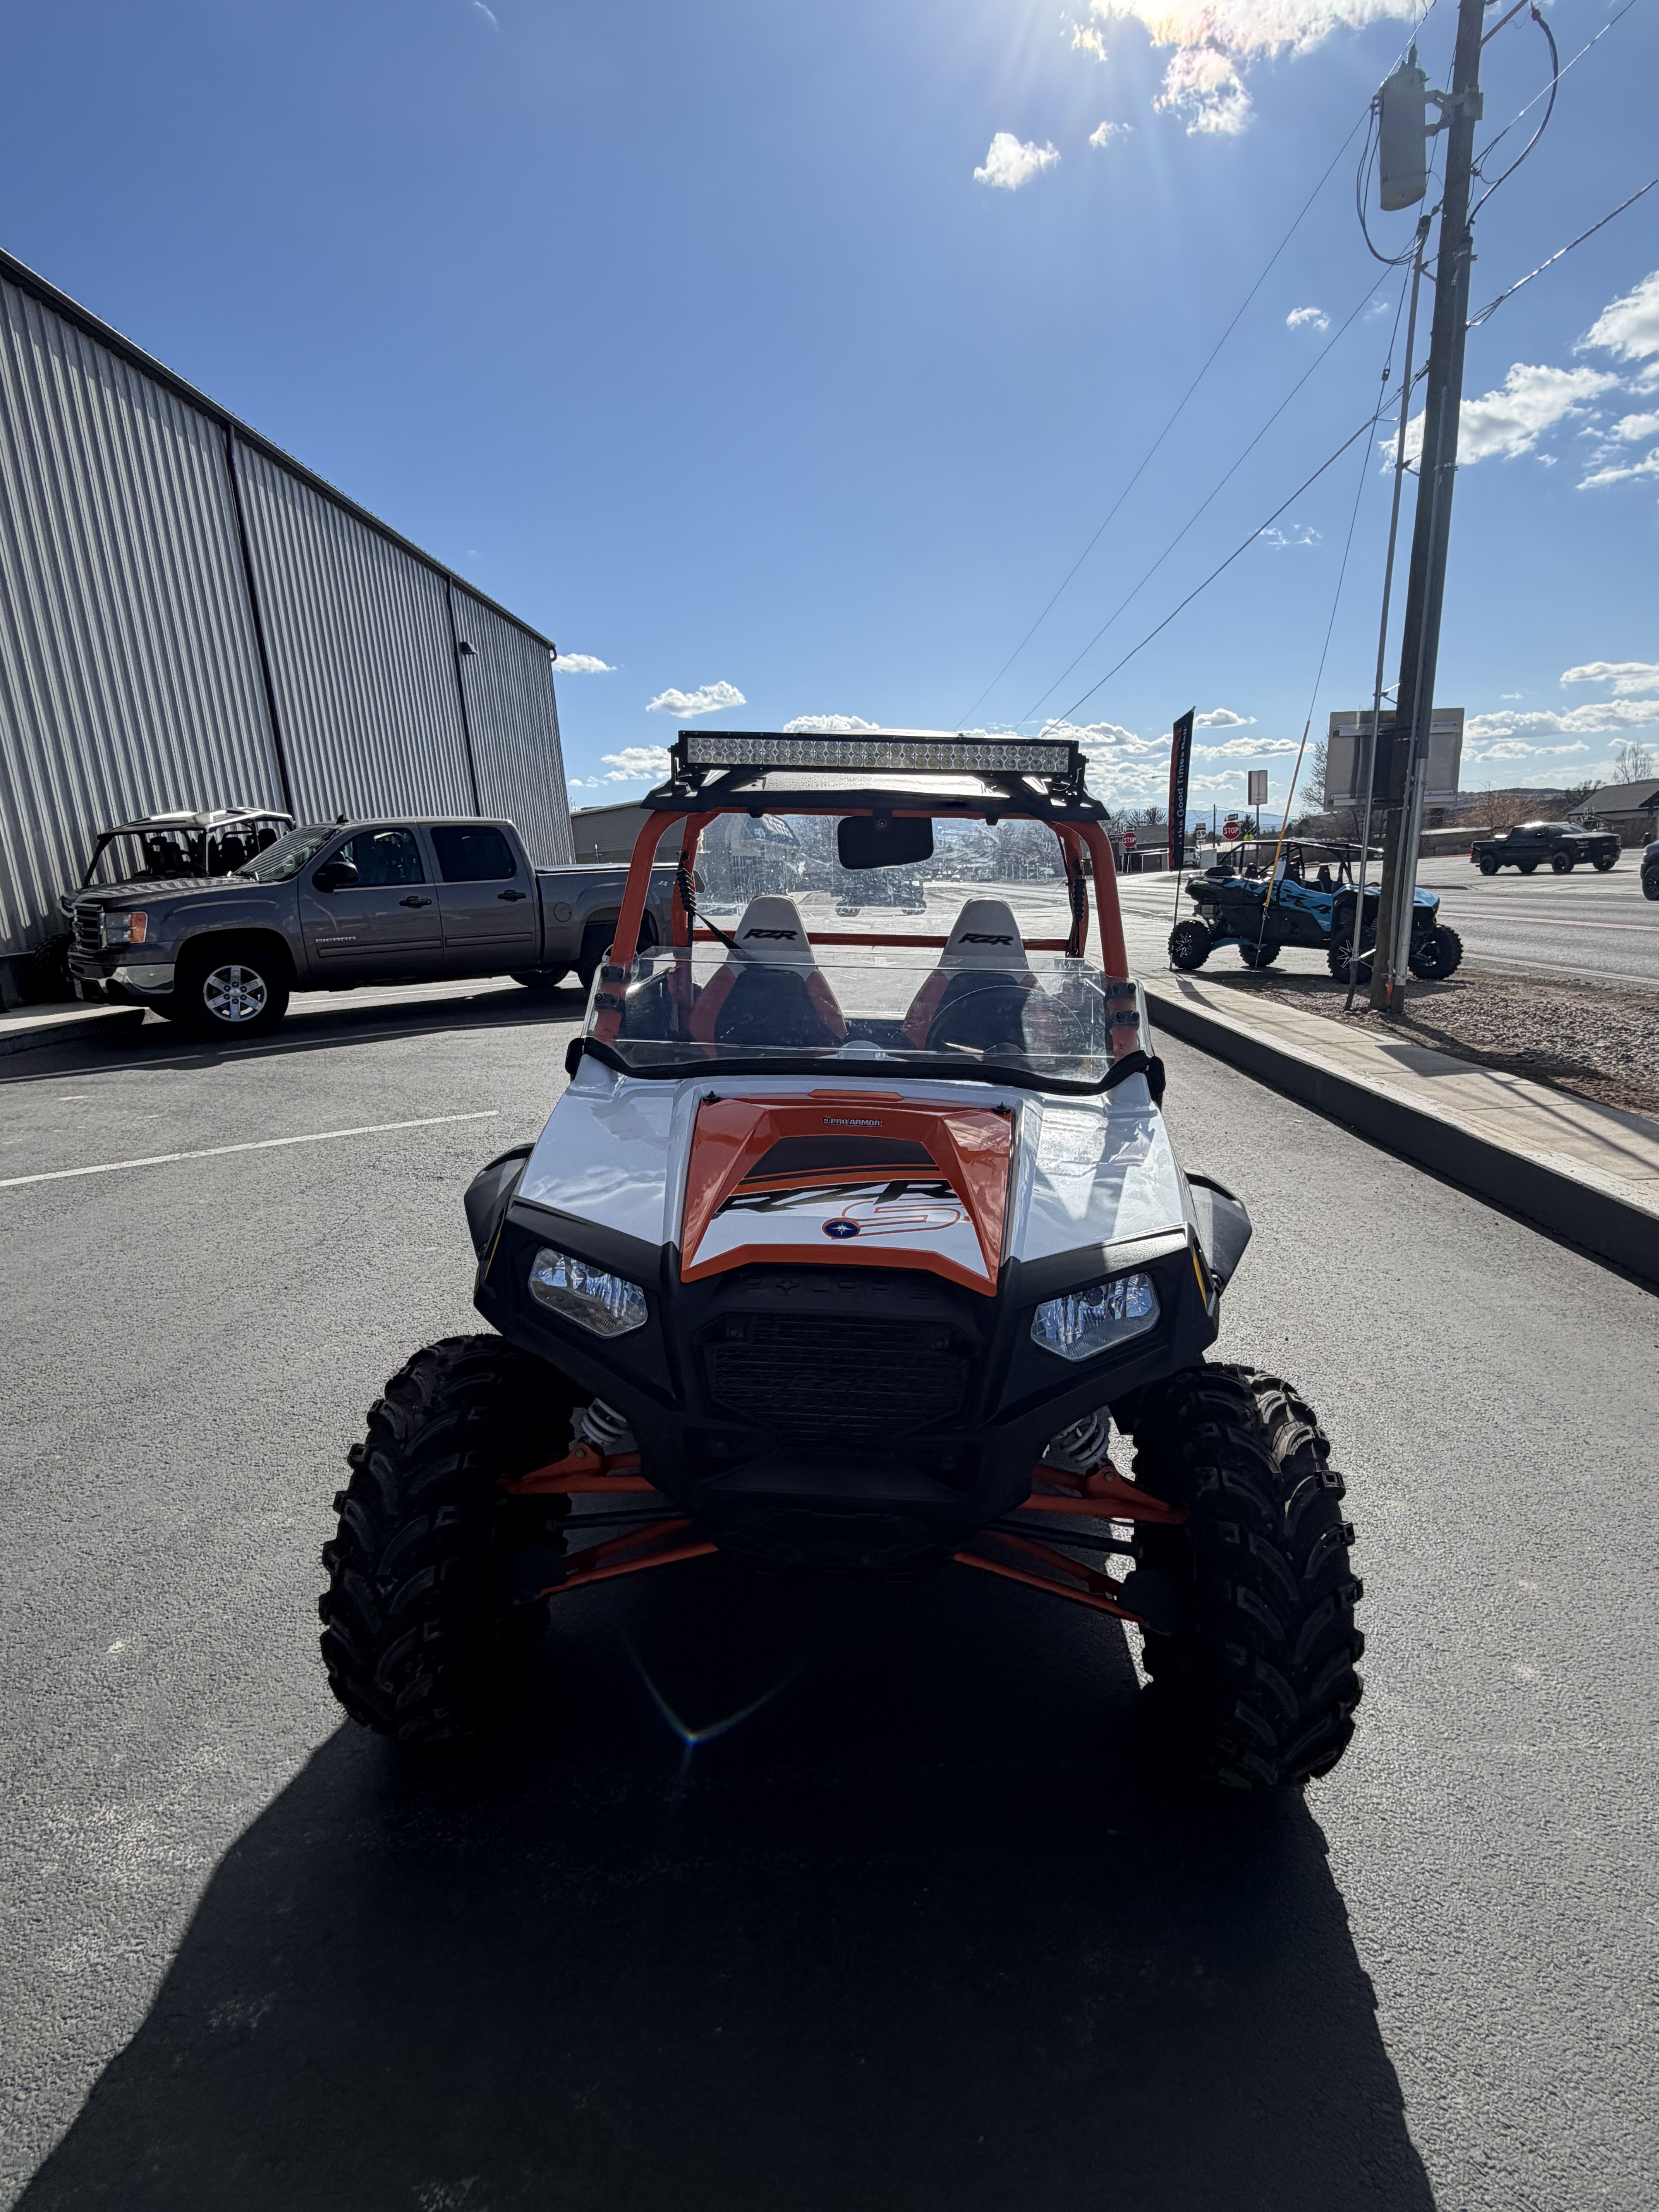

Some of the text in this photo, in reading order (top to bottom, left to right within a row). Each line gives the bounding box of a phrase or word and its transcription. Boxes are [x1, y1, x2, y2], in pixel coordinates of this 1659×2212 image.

[743, 929, 798, 941] RZR
[958, 933, 1014, 946] RZR
[711, 1180, 960, 1220] RZR
